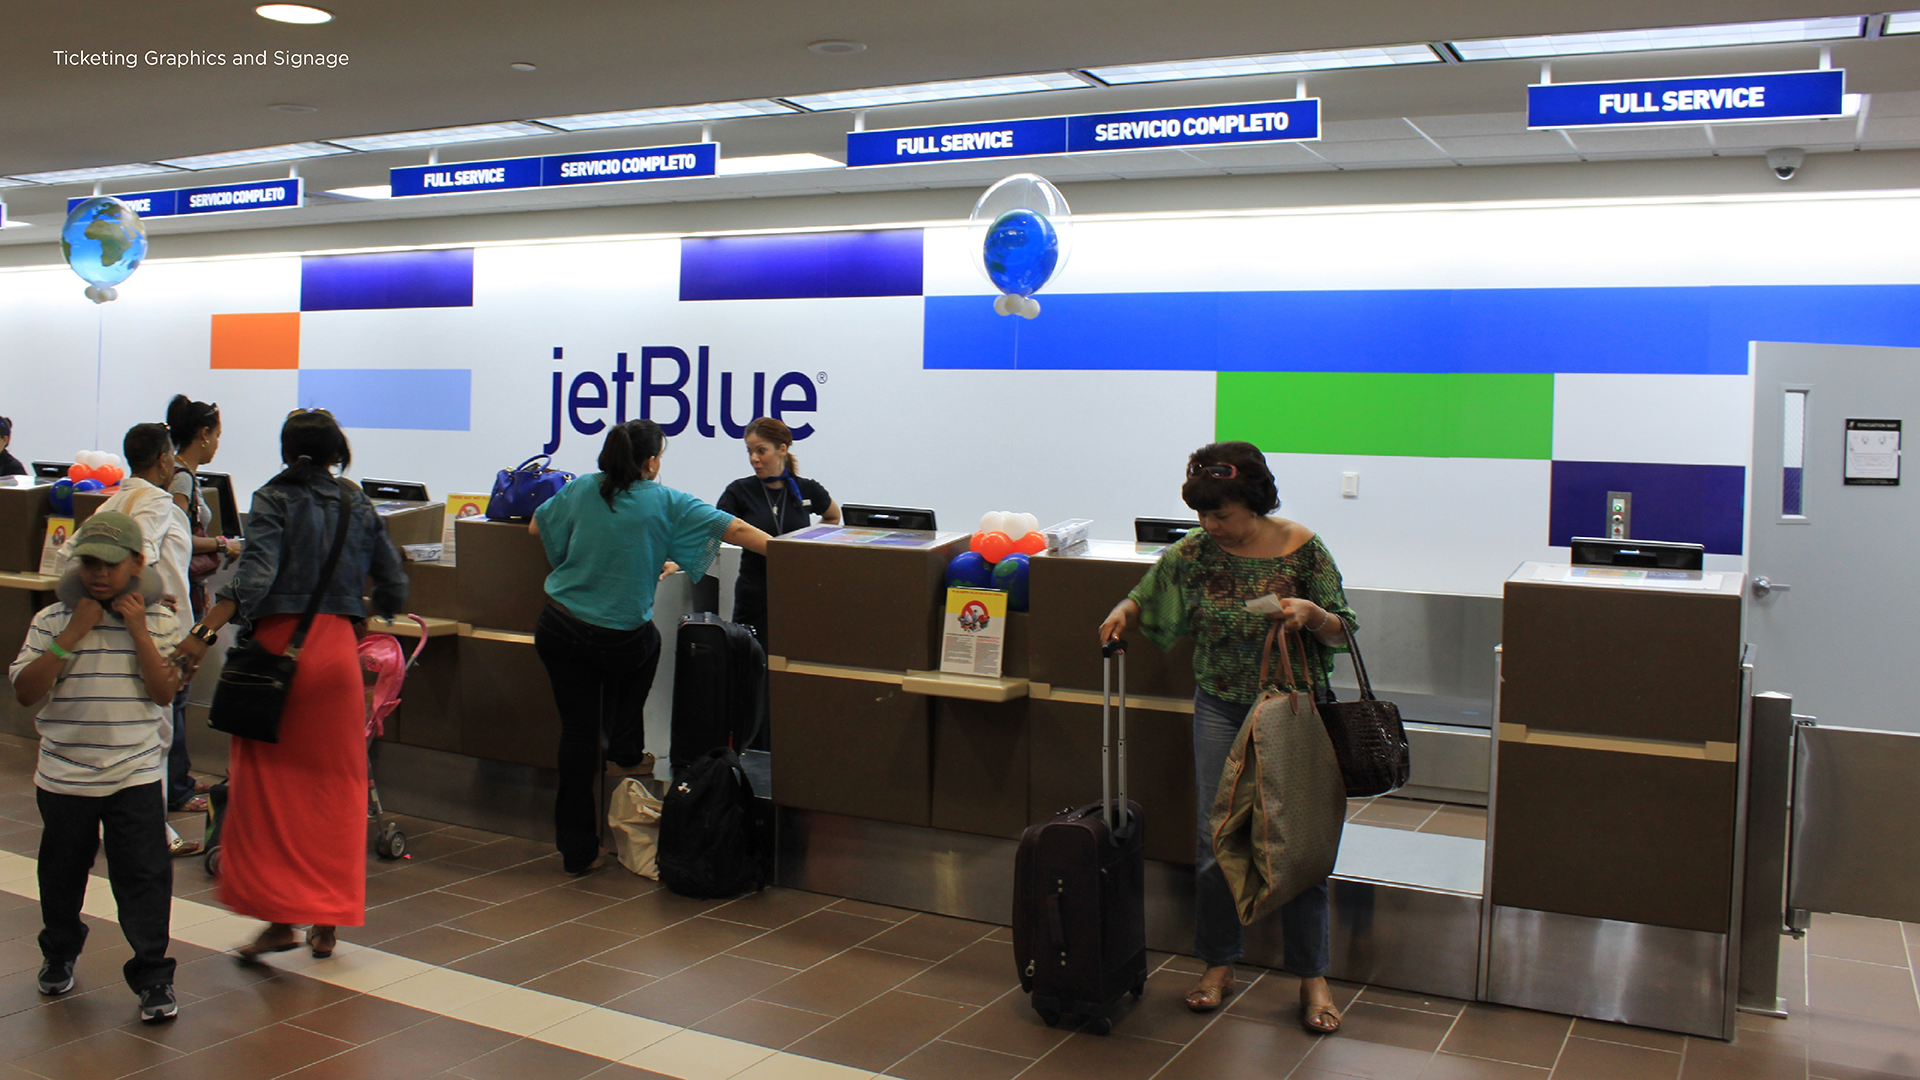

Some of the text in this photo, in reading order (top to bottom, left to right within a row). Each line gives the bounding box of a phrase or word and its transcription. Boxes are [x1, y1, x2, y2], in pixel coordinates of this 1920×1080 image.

[1599, 86, 1765, 114] FULL SERVICE
[1095, 112, 1289, 142] SERVICIO COMPLETO
[896, 130, 1013, 155] FULL SERVICE
[423, 167, 505, 188] FULL SERVICE
[560, 153, 696, 178] SERVICIO COMPLETO
[189, 186, 285, 208] SERVICIO COMPLETO
[543, 345, 817, 455] jetBlue
